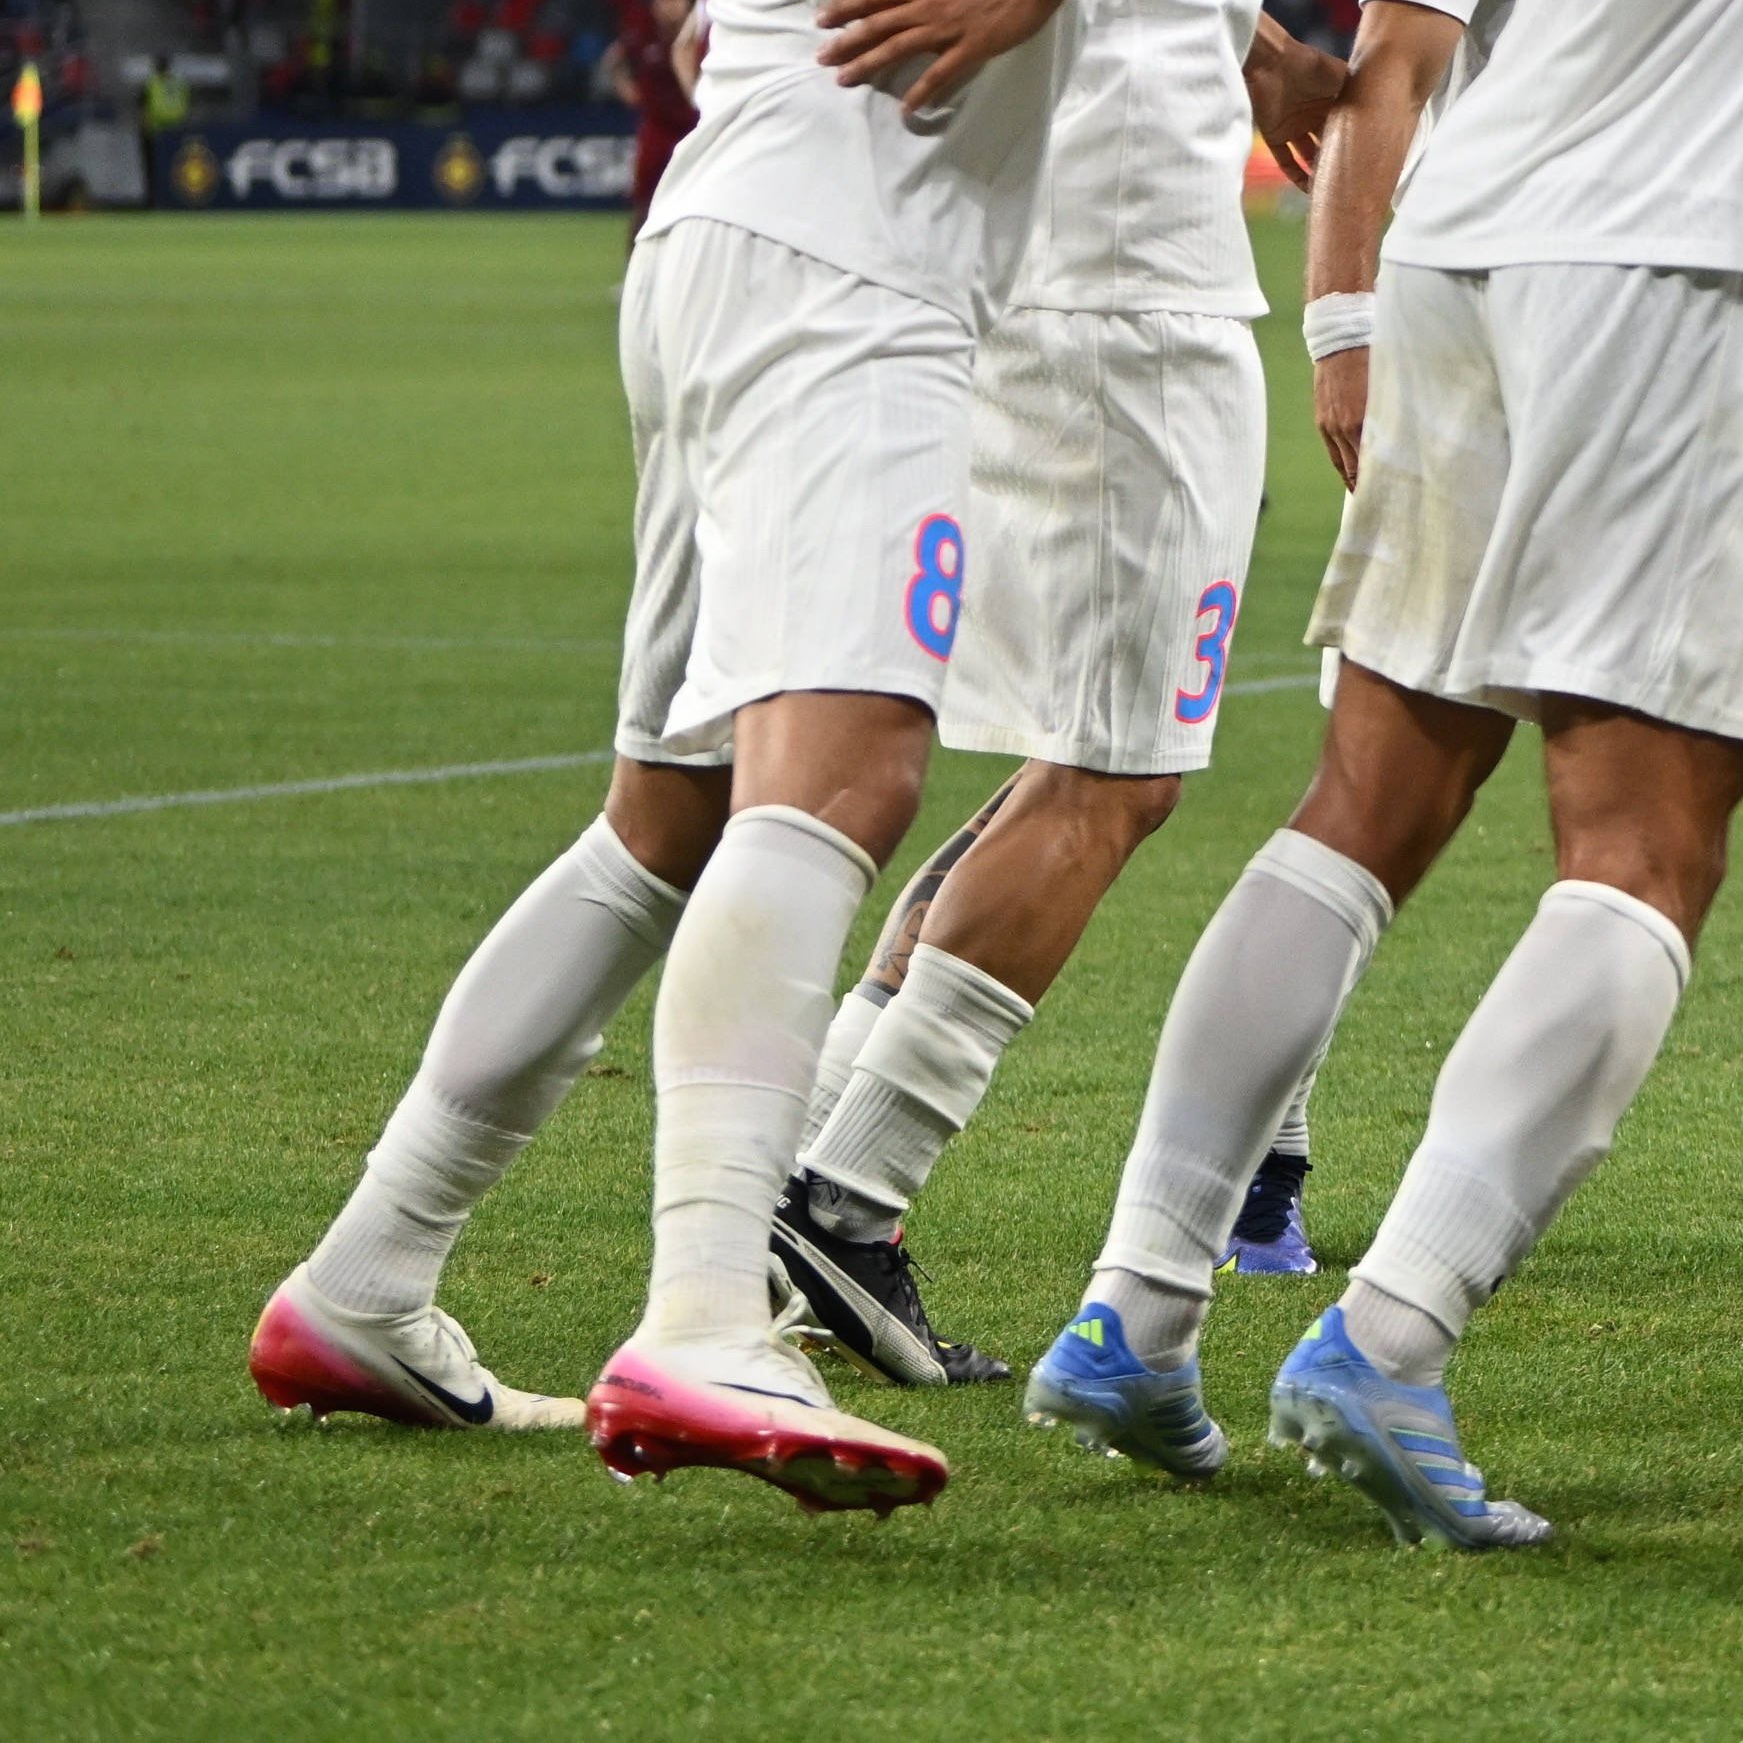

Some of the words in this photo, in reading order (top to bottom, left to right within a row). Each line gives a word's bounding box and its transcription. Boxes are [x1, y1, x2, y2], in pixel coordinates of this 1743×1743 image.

[226, 137, 399, 200] FCSB
[492, 135, 639, 199] FCS
[903, 512, 965, 663] 8
[1174, 579, 1238, 725] 3
